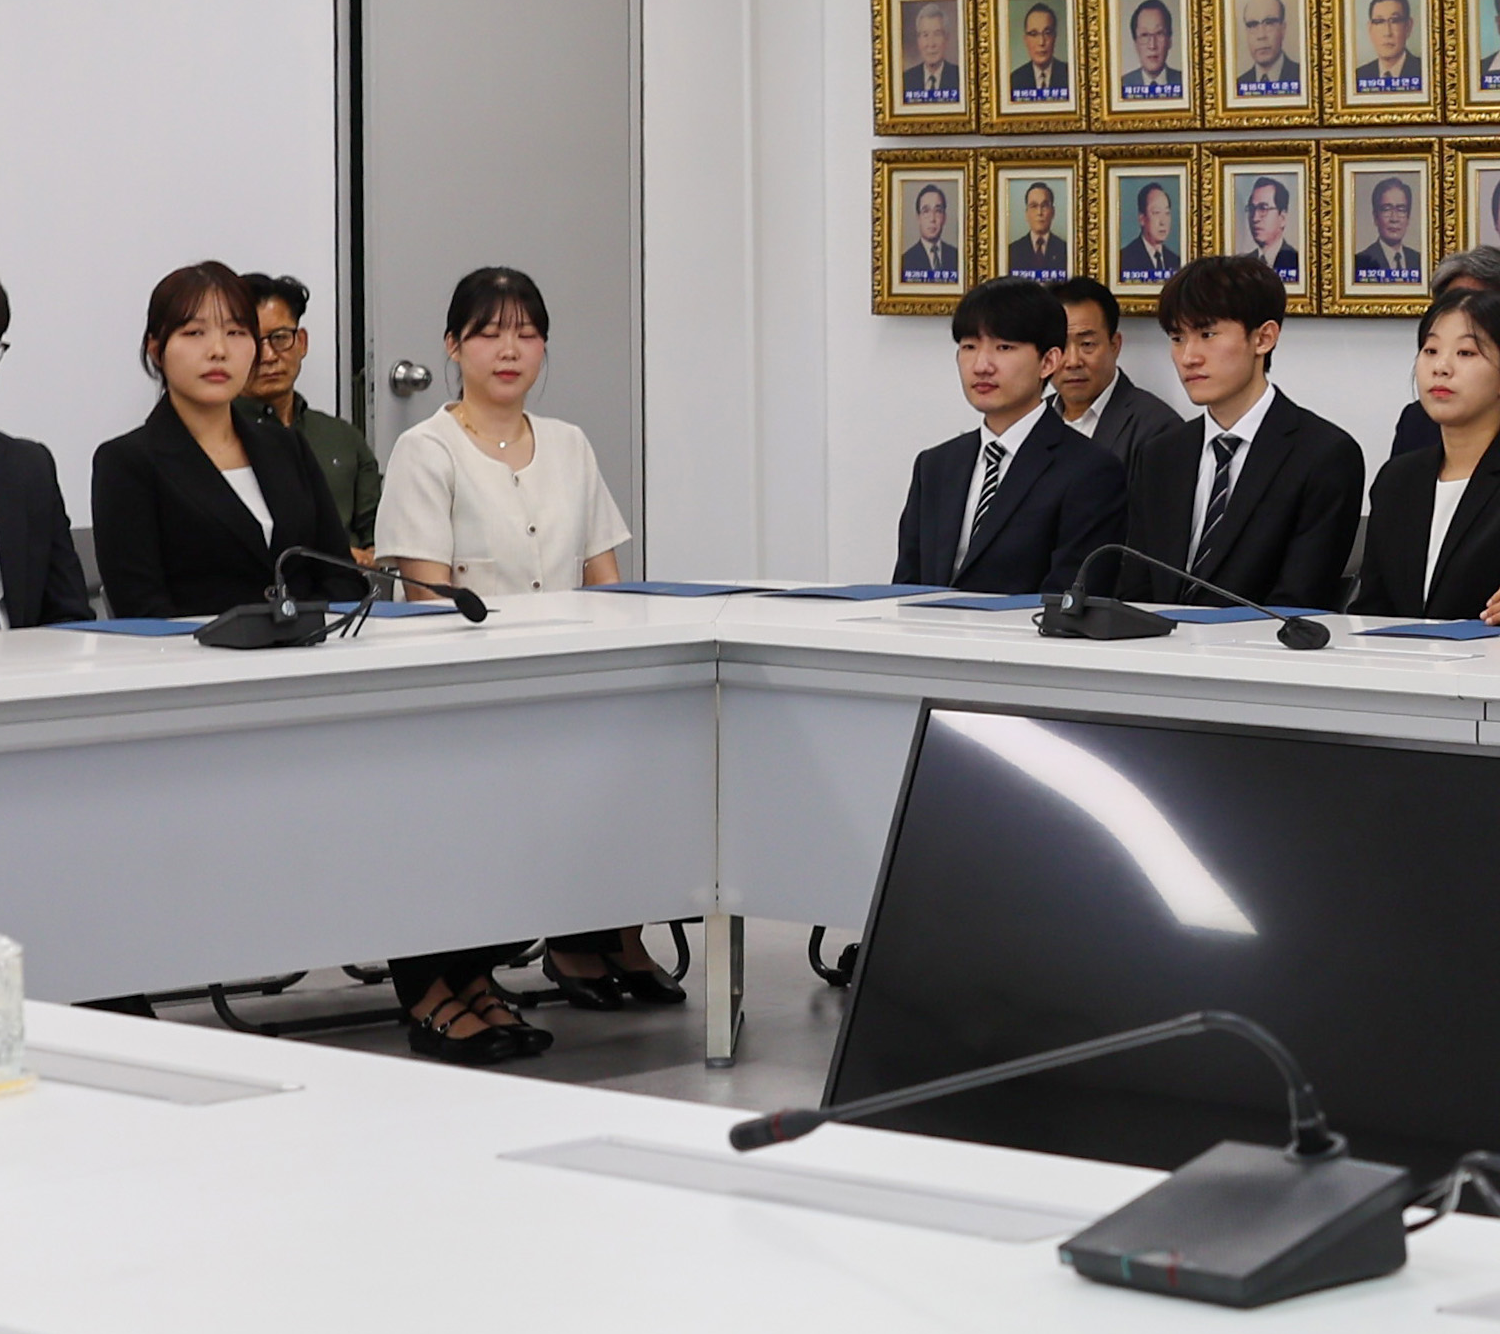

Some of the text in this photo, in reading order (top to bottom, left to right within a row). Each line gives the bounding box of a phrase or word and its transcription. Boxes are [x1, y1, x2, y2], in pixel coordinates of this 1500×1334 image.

[1359, 79, 1385, 88] 제19대
[1125, 86, 1149, 94] 제17대
[1358, 270, 1385, 278] 제32대
